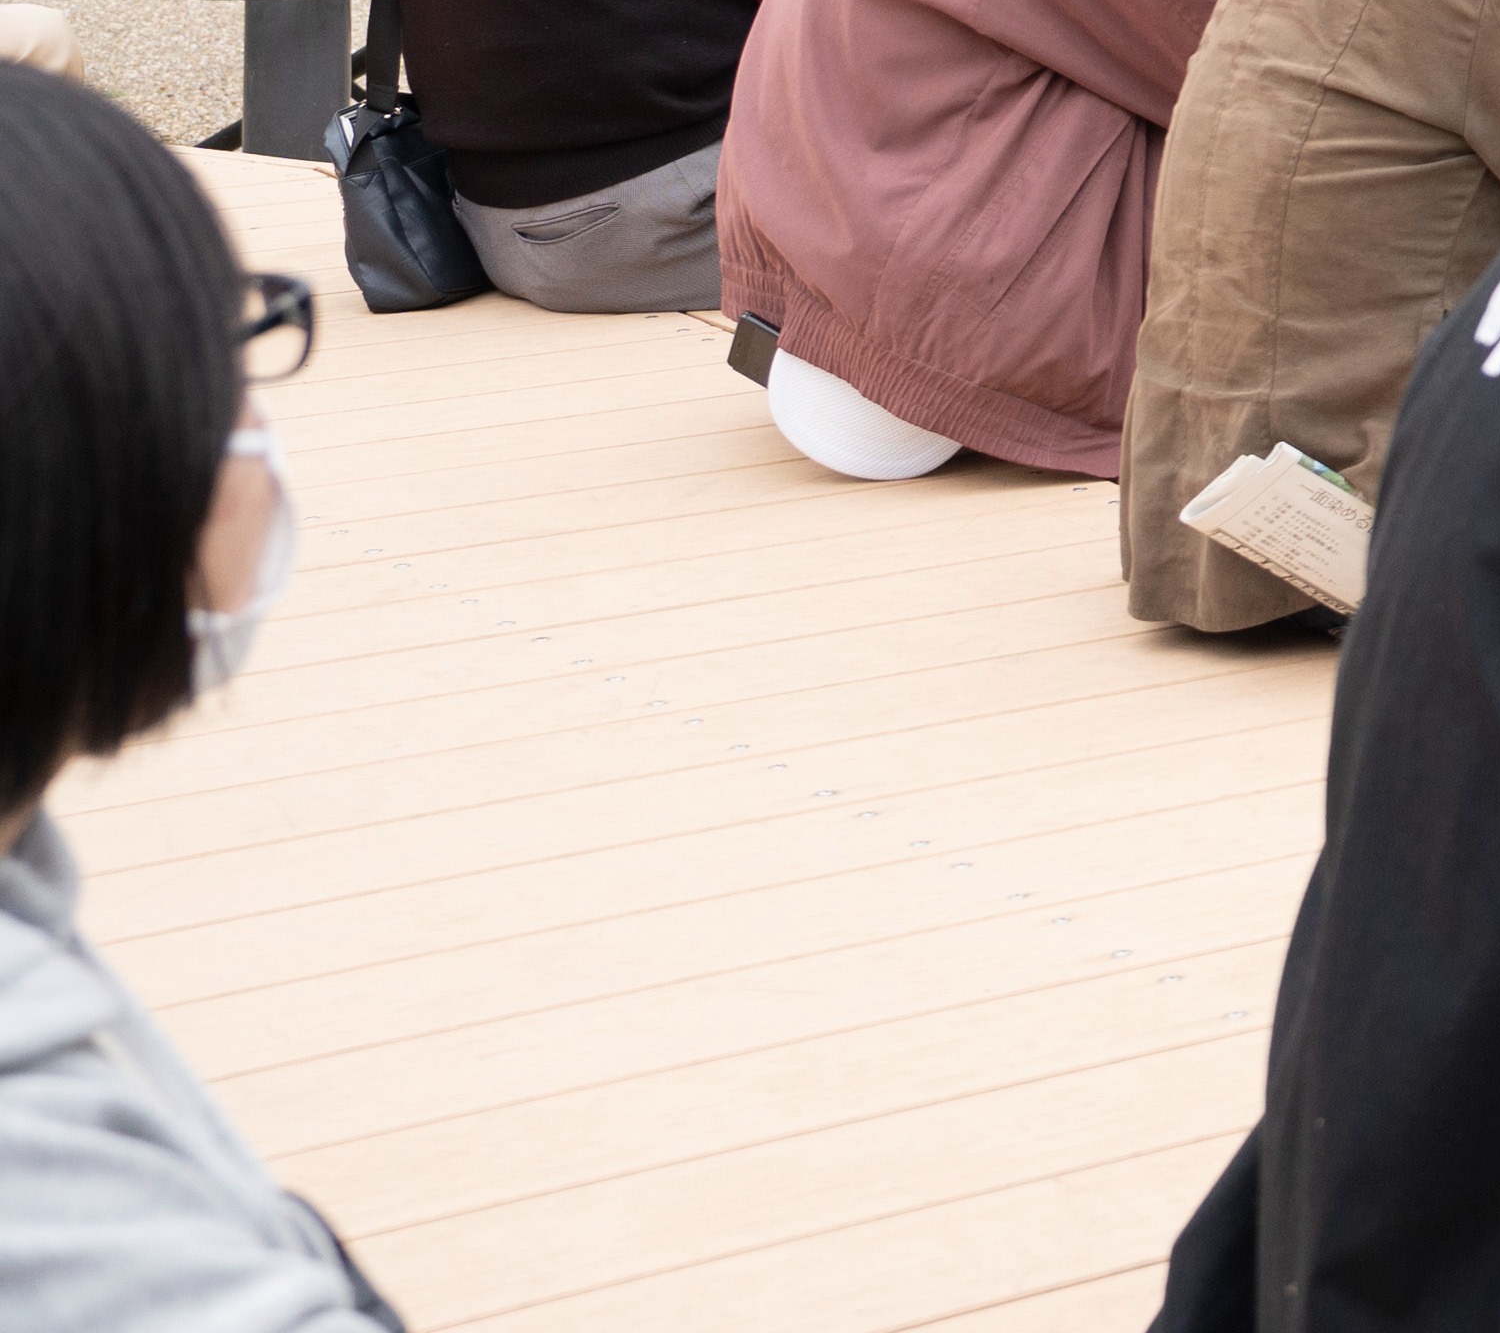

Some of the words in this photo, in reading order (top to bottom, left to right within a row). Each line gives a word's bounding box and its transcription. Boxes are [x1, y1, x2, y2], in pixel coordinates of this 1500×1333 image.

[1299, 483, 1375, 533] 一面染める
